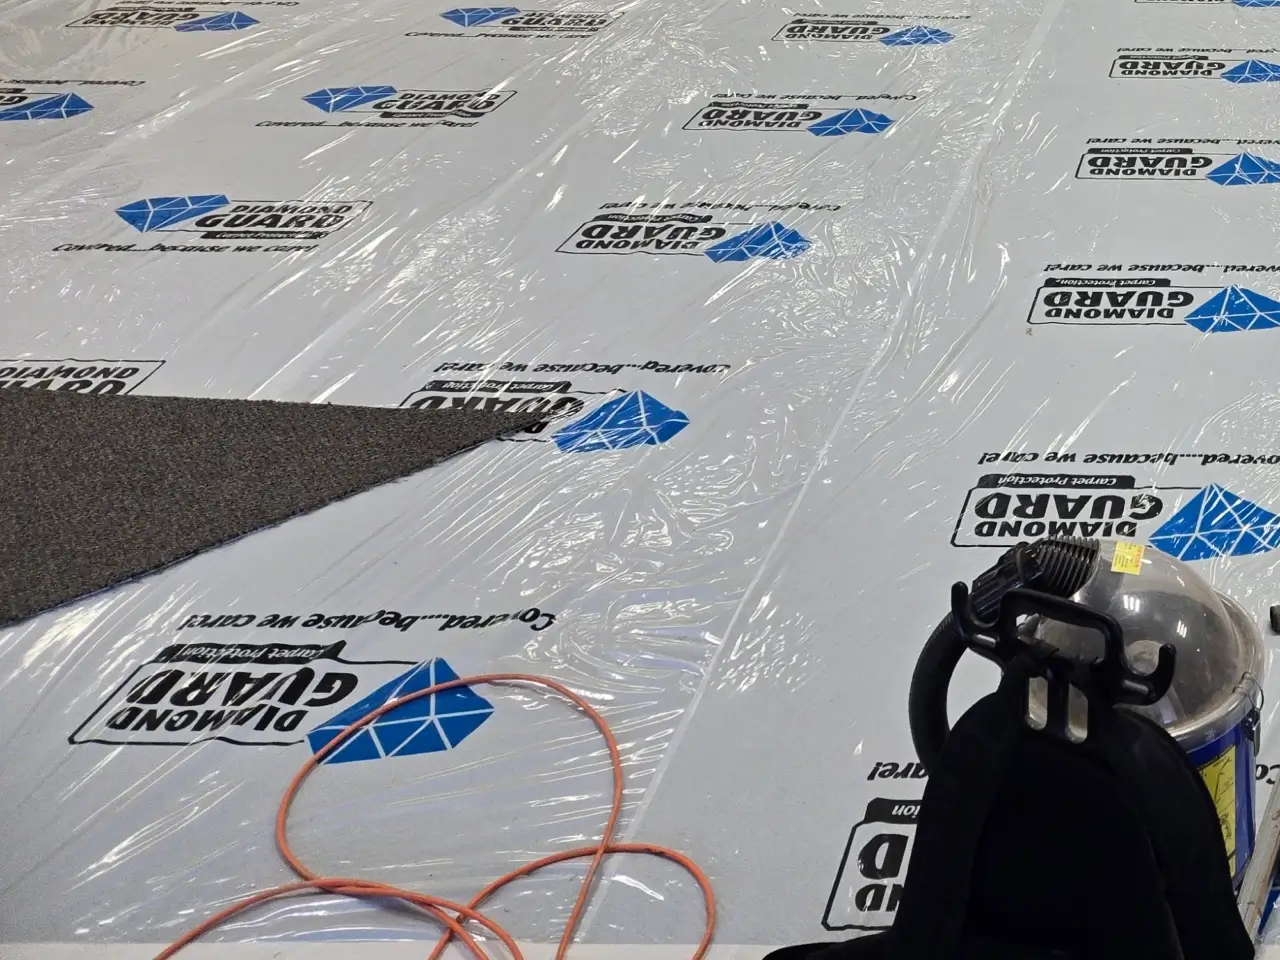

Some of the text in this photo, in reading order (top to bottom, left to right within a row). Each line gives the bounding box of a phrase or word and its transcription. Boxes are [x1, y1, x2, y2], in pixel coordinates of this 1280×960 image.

[89, 12, 200, 20] GUARD
[786, 26, 891, 35] GUARD
[1119, 61, 1226, 70] GUARD
[701, 109, 822, 121] GUARD
[698, 120, 801, 128] DIAMOND
[1087, 156, 1212, 168] GUARD
[1089, 168, 1196, 176] DIAMOND
[229, 204, 352, 214] DIAMOND
[195, 213, 345, 228] GUARD
[581, 224, 726, 240] GUARD
[232, 244, 260, 253] we
[575, 239, 700, 249] DIAMOND
[1044, 263, 1093, 273] care!
[1096, 264, 1122, 272] we
[1044, 291, 1194, 308] GUARD
[1044, 308, 1174, 318] DIAMOND
[499, 362, 529, 373] we
[978, 452, 1040, 466] care!
[1045, 452, 1077, 463] we
[998, 475, 1116, 486] Carpet Protection
[974, 493, 1163, 520] GUARD
[974, 521, 1137, 537] DIAMOND
[179, 613, 256, 631] care!
[259, 614, 299, 628] we
[125, 667, 358, 708] GUARD
[106, 707, 309, 732] DIAMOND
[867, 762, 928, 780] are!
